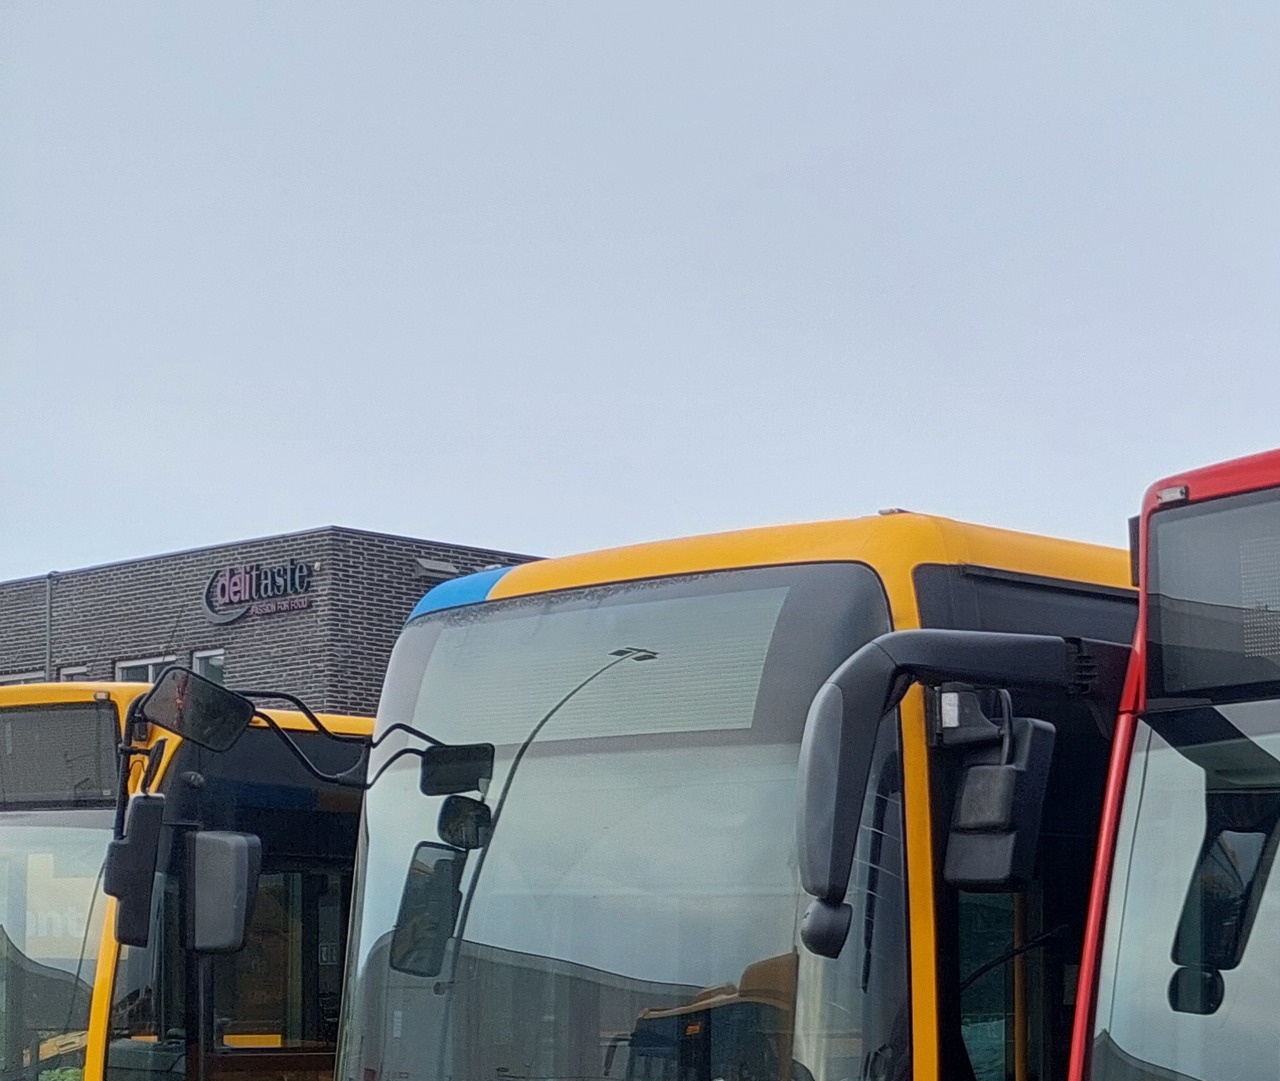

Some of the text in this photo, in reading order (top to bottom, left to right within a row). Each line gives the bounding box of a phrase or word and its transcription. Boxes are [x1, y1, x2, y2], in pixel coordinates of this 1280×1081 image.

[217, 559, 308, 604] delitaste
[277, 601, 290, 611] FOR
[291, 598, 308, 609] FOOD
